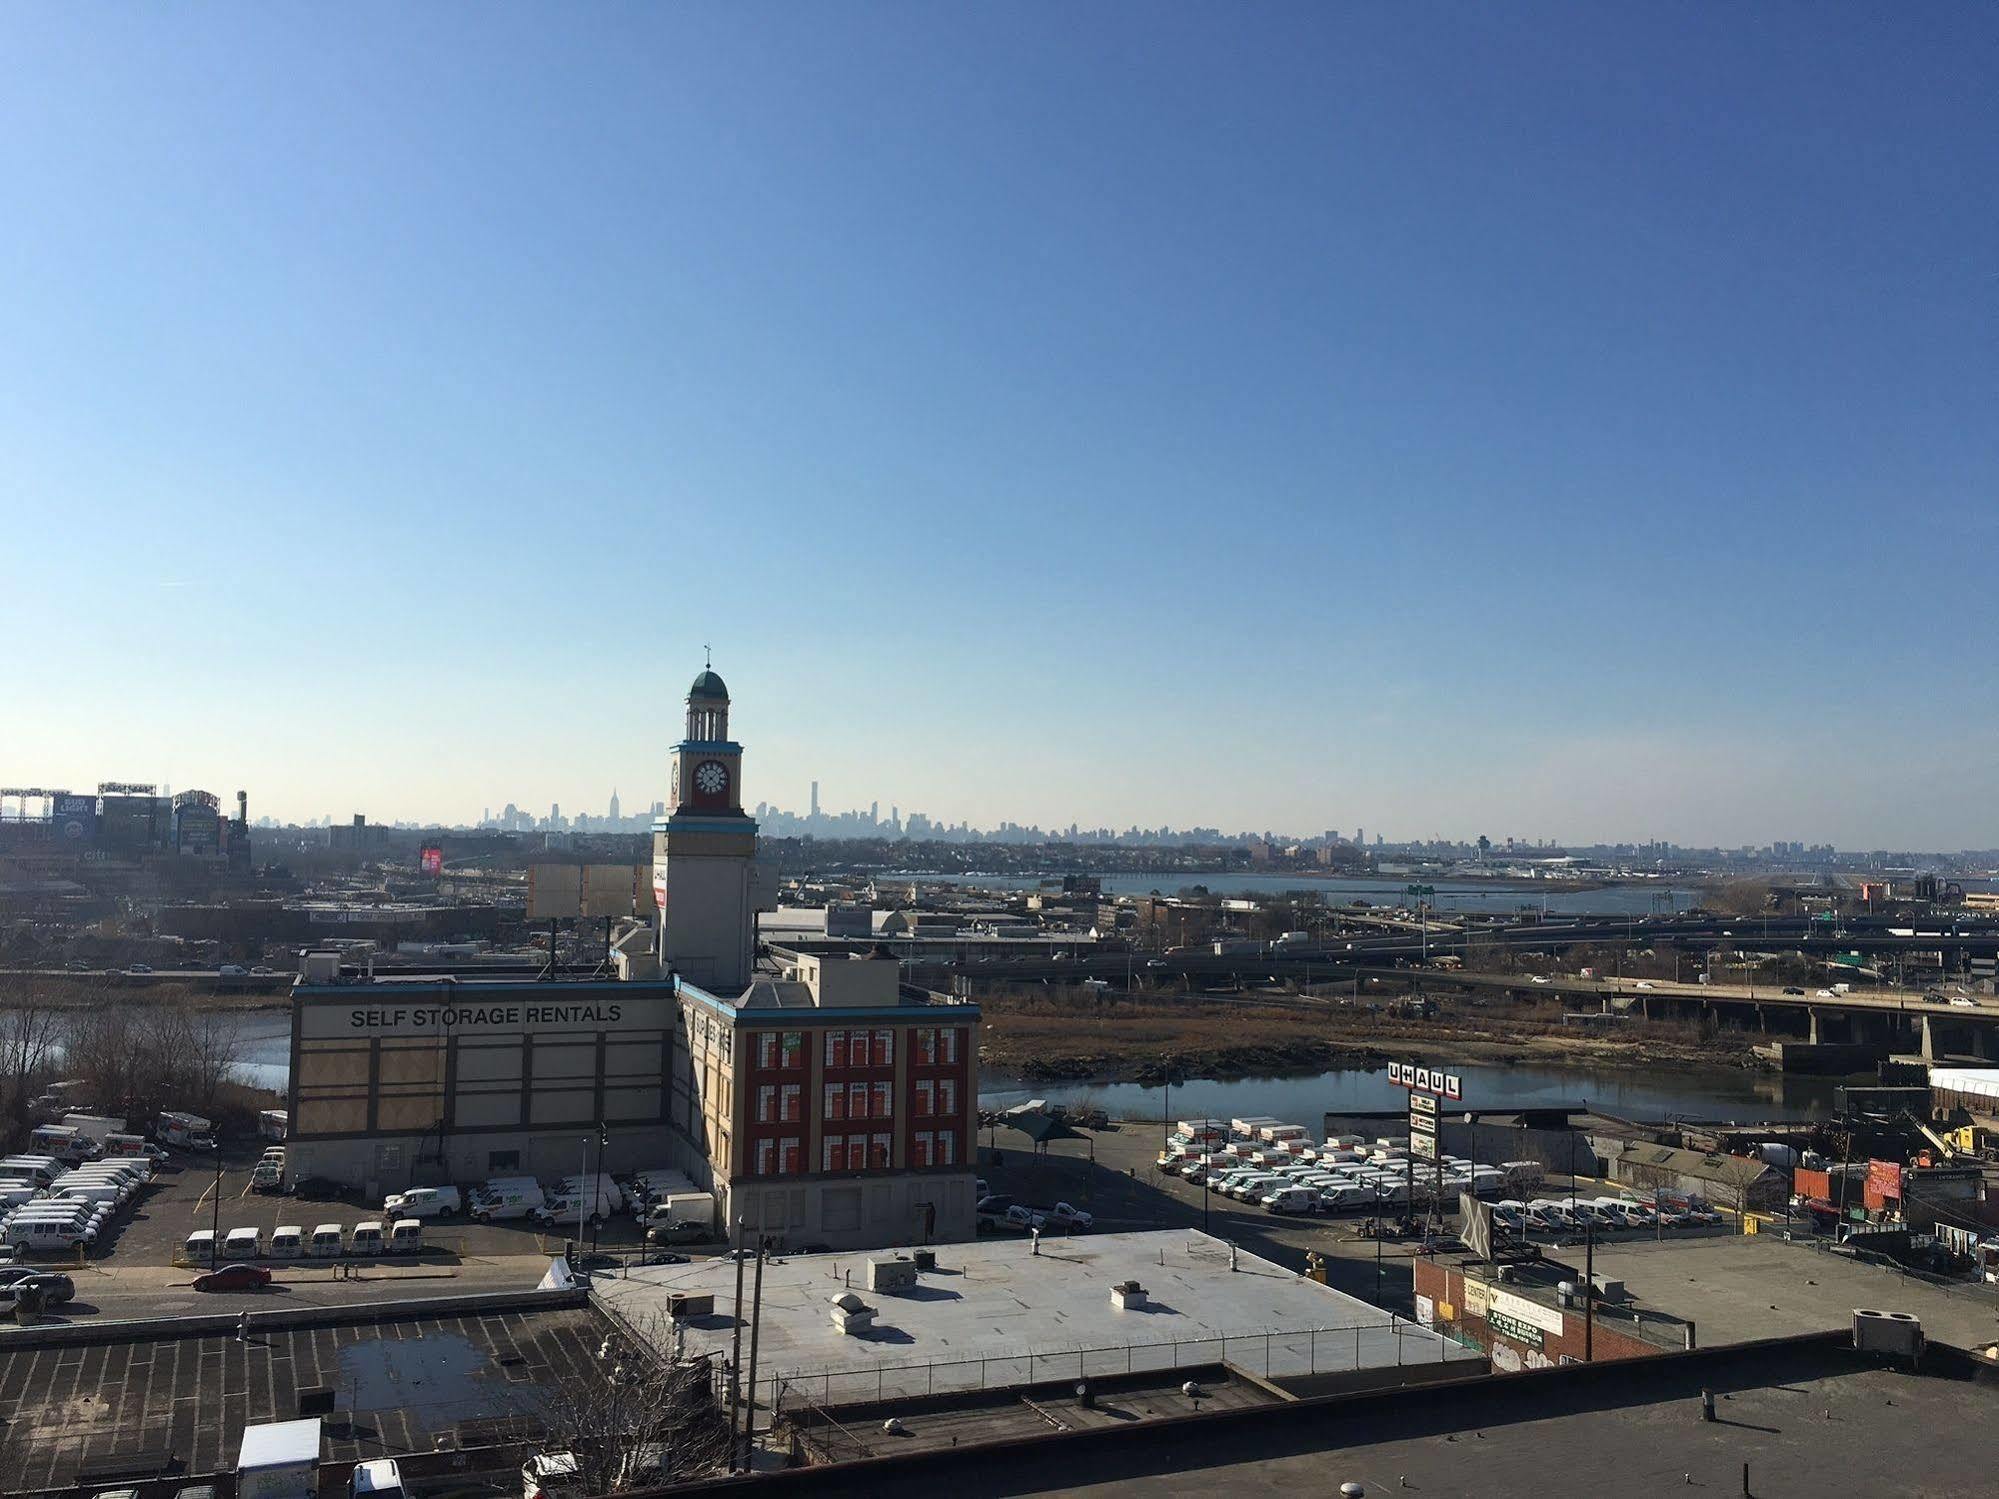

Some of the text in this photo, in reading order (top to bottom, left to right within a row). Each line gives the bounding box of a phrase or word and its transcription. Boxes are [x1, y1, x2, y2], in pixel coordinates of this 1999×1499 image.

[350, 1004, 621, 1027] SELF STORAGE RENTALS
[1466, 1284, 1486, 1300] CENTER
[1492, 1311, 1517, 1326] STONE
[1517, 1320, 1538, 1334] EXPO
